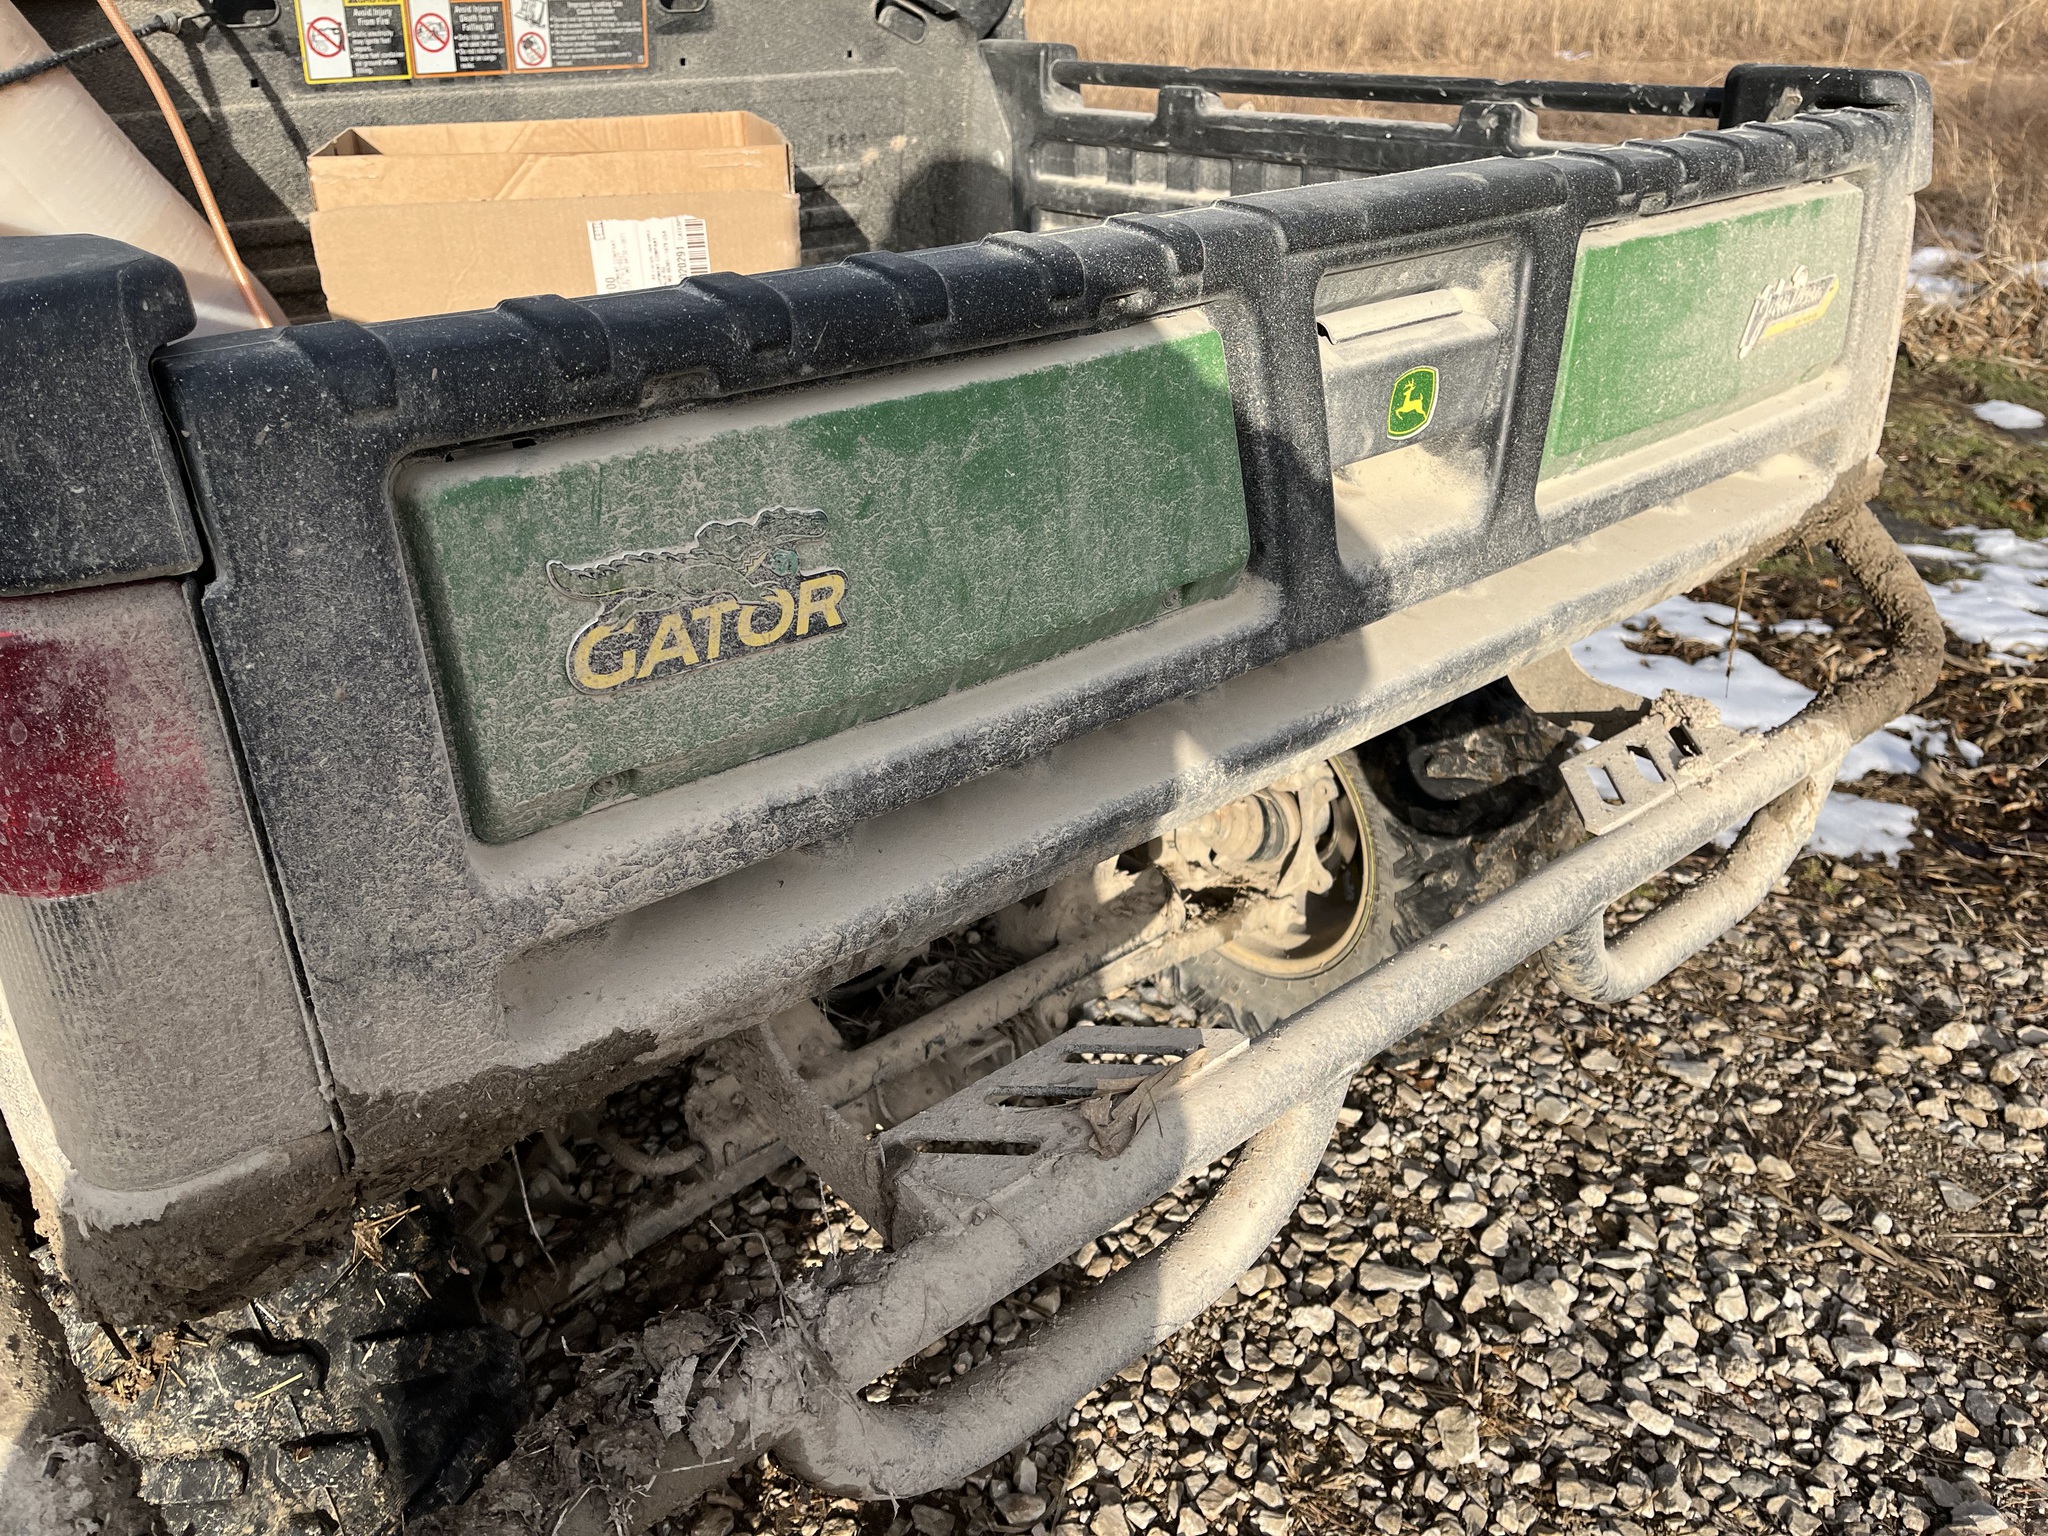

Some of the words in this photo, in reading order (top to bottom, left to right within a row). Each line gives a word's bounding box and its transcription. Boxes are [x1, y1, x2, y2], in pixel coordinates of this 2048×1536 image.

[353, 8, 372, 16] Avoid
[373, 8, 393, 17] Injury
[473, 6, 491, 14] Injury
[376, 17, 390, 25] Fire
[462, 23, 484, 32] Falling
[573, 574, 846, 690] GATOR
